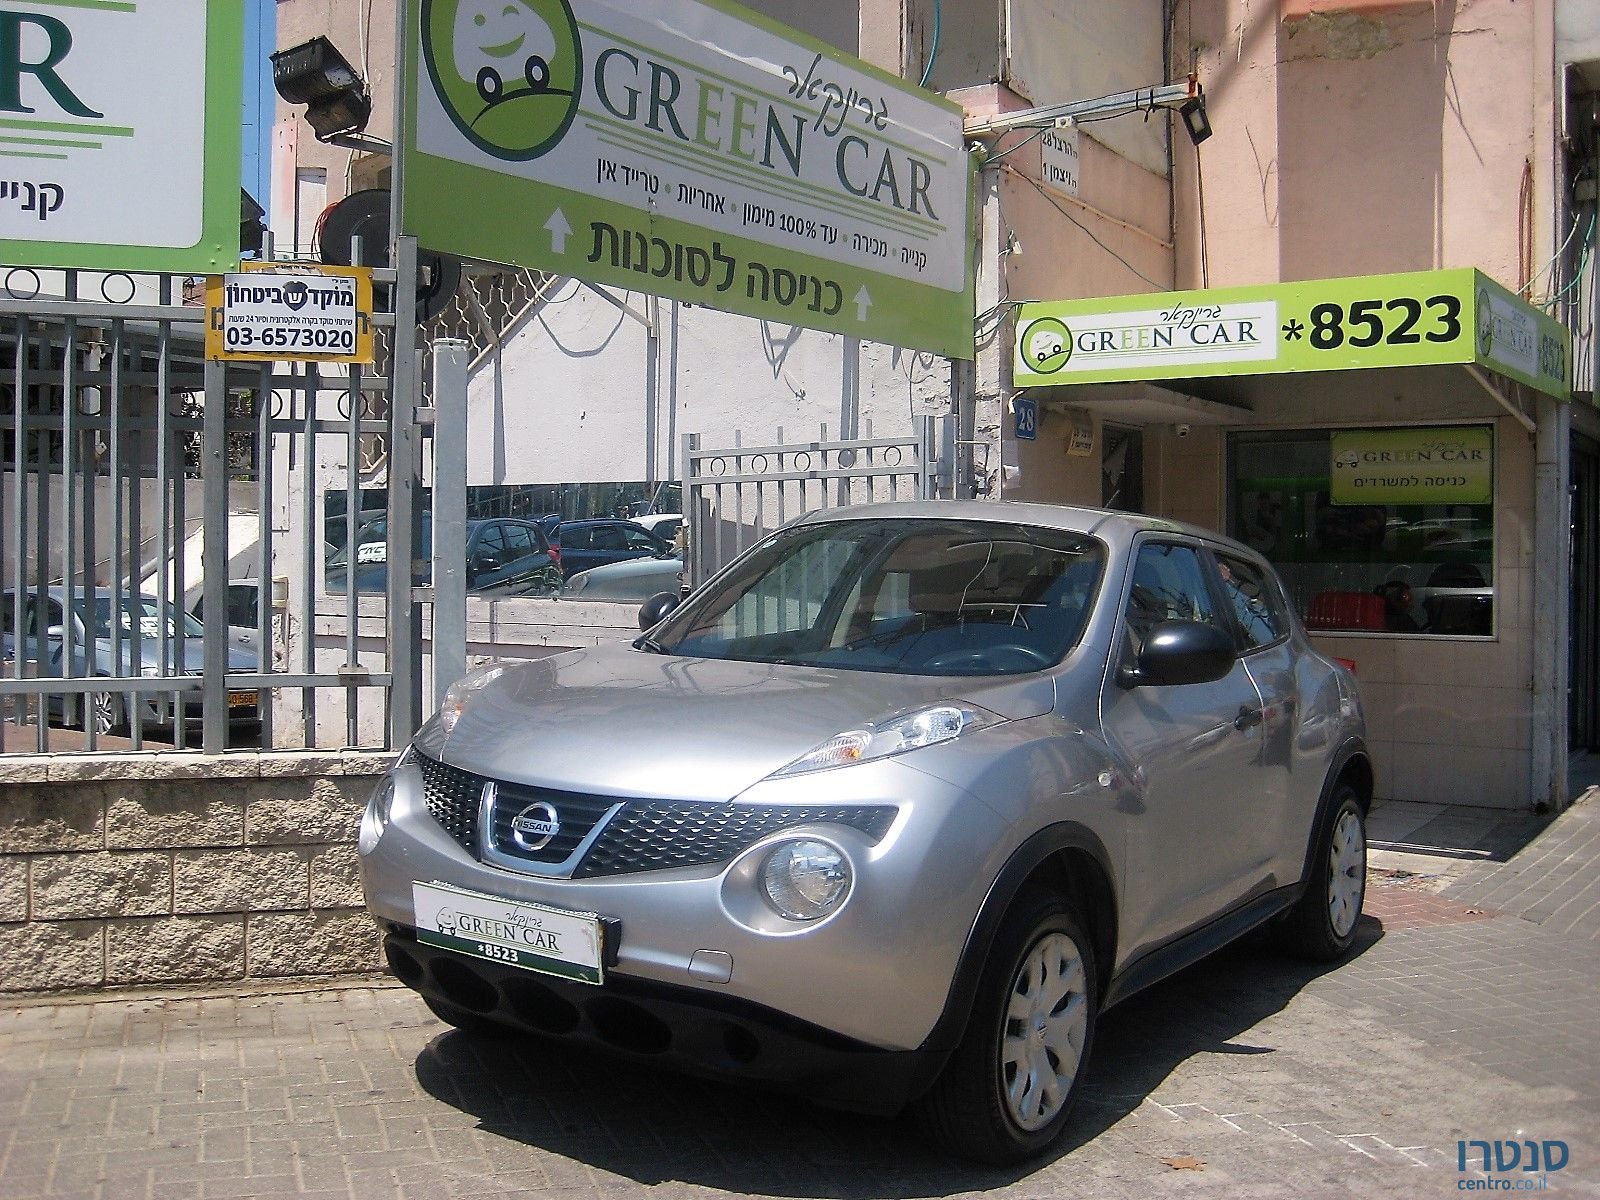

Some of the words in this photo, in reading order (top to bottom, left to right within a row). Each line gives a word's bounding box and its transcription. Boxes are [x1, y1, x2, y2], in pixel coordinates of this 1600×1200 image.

[594, 48, 807, 177] GREEN
[836, 135, 939, 221] CAR
[597, 158, 617, 184] אין
[621, 165, 659, 194] טרייד
[677, 183, 725, 214] אחריות
[743, 203, 775, 228] מימון
[779, 213, 817, 239] 100%
[820, 224, 838, 245] עד
[853, 233, 888, 258] מכירה
[587, 221, 736, 292] לסוכנות
[901, 247, 927, 272] קנייה
[746, 262, 843, 316] כניסה
[245, 315, 254, 323] 24
[226, 327, 354, 348] 03-6573020
[1077, 326, 1174, 352] GREEN
[1190, 321, 1259, 345] CAR
[1018, 407, 1034, 432] 28
[1441, 449, 1483, 461] CAR
[1354, 475, 1419, 487] למשרדים
[1425, 476, 1466, 487] כניסה
[459, 915, 515, 940] GREEN
[523, 928, 560, 951] CAR
